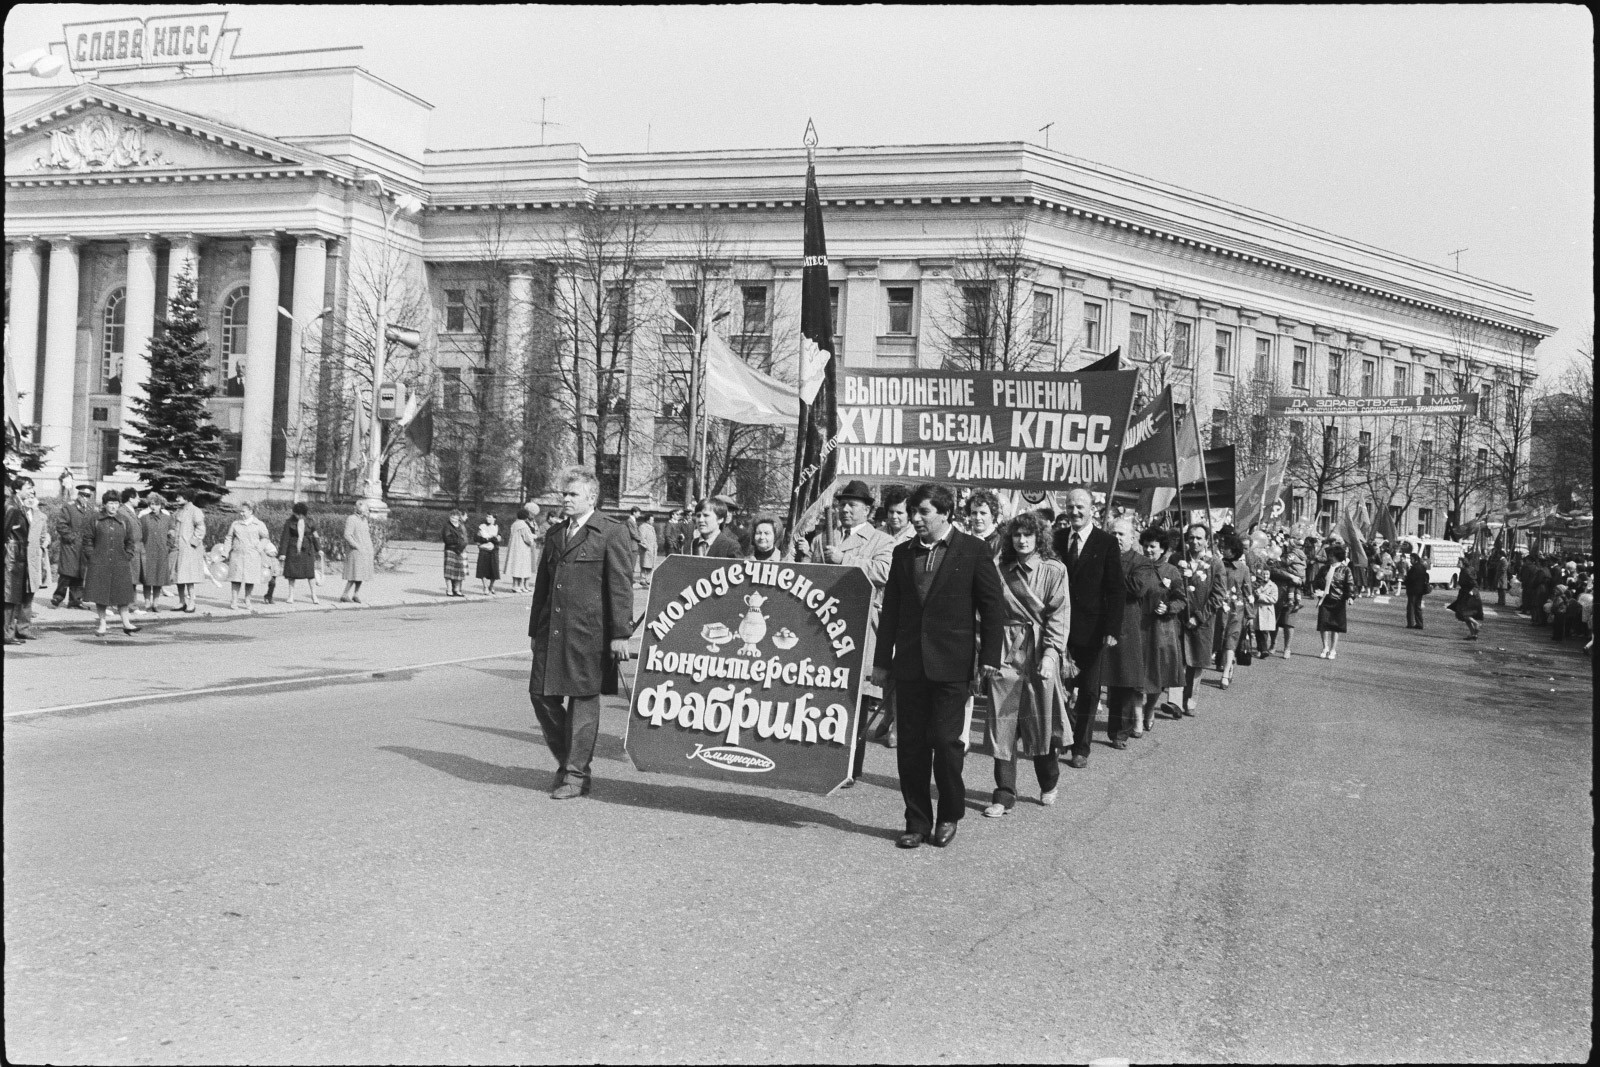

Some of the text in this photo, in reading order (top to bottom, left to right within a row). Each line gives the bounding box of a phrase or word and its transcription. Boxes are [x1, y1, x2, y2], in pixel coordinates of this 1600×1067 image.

[76, 25, 209, 61] СЛАВА КПСС
[844, 376, 1082, 411] ВЫПОЛНЕНИЕ РЕШЕНИЙ
[1292, 399, 1309, 408] ДА
[1316, 398, 1407, 408] ЗДРАВСТВУЕТ
[1010, 411, 1112, 452] КПСС
[836, 447, 1108, 484] АНТИРУЕМ УДАНЫМ ТРУДОМ
[646, 644, 850, 689] кондитерская
[686, 743, 772, 767] Коммунарка
